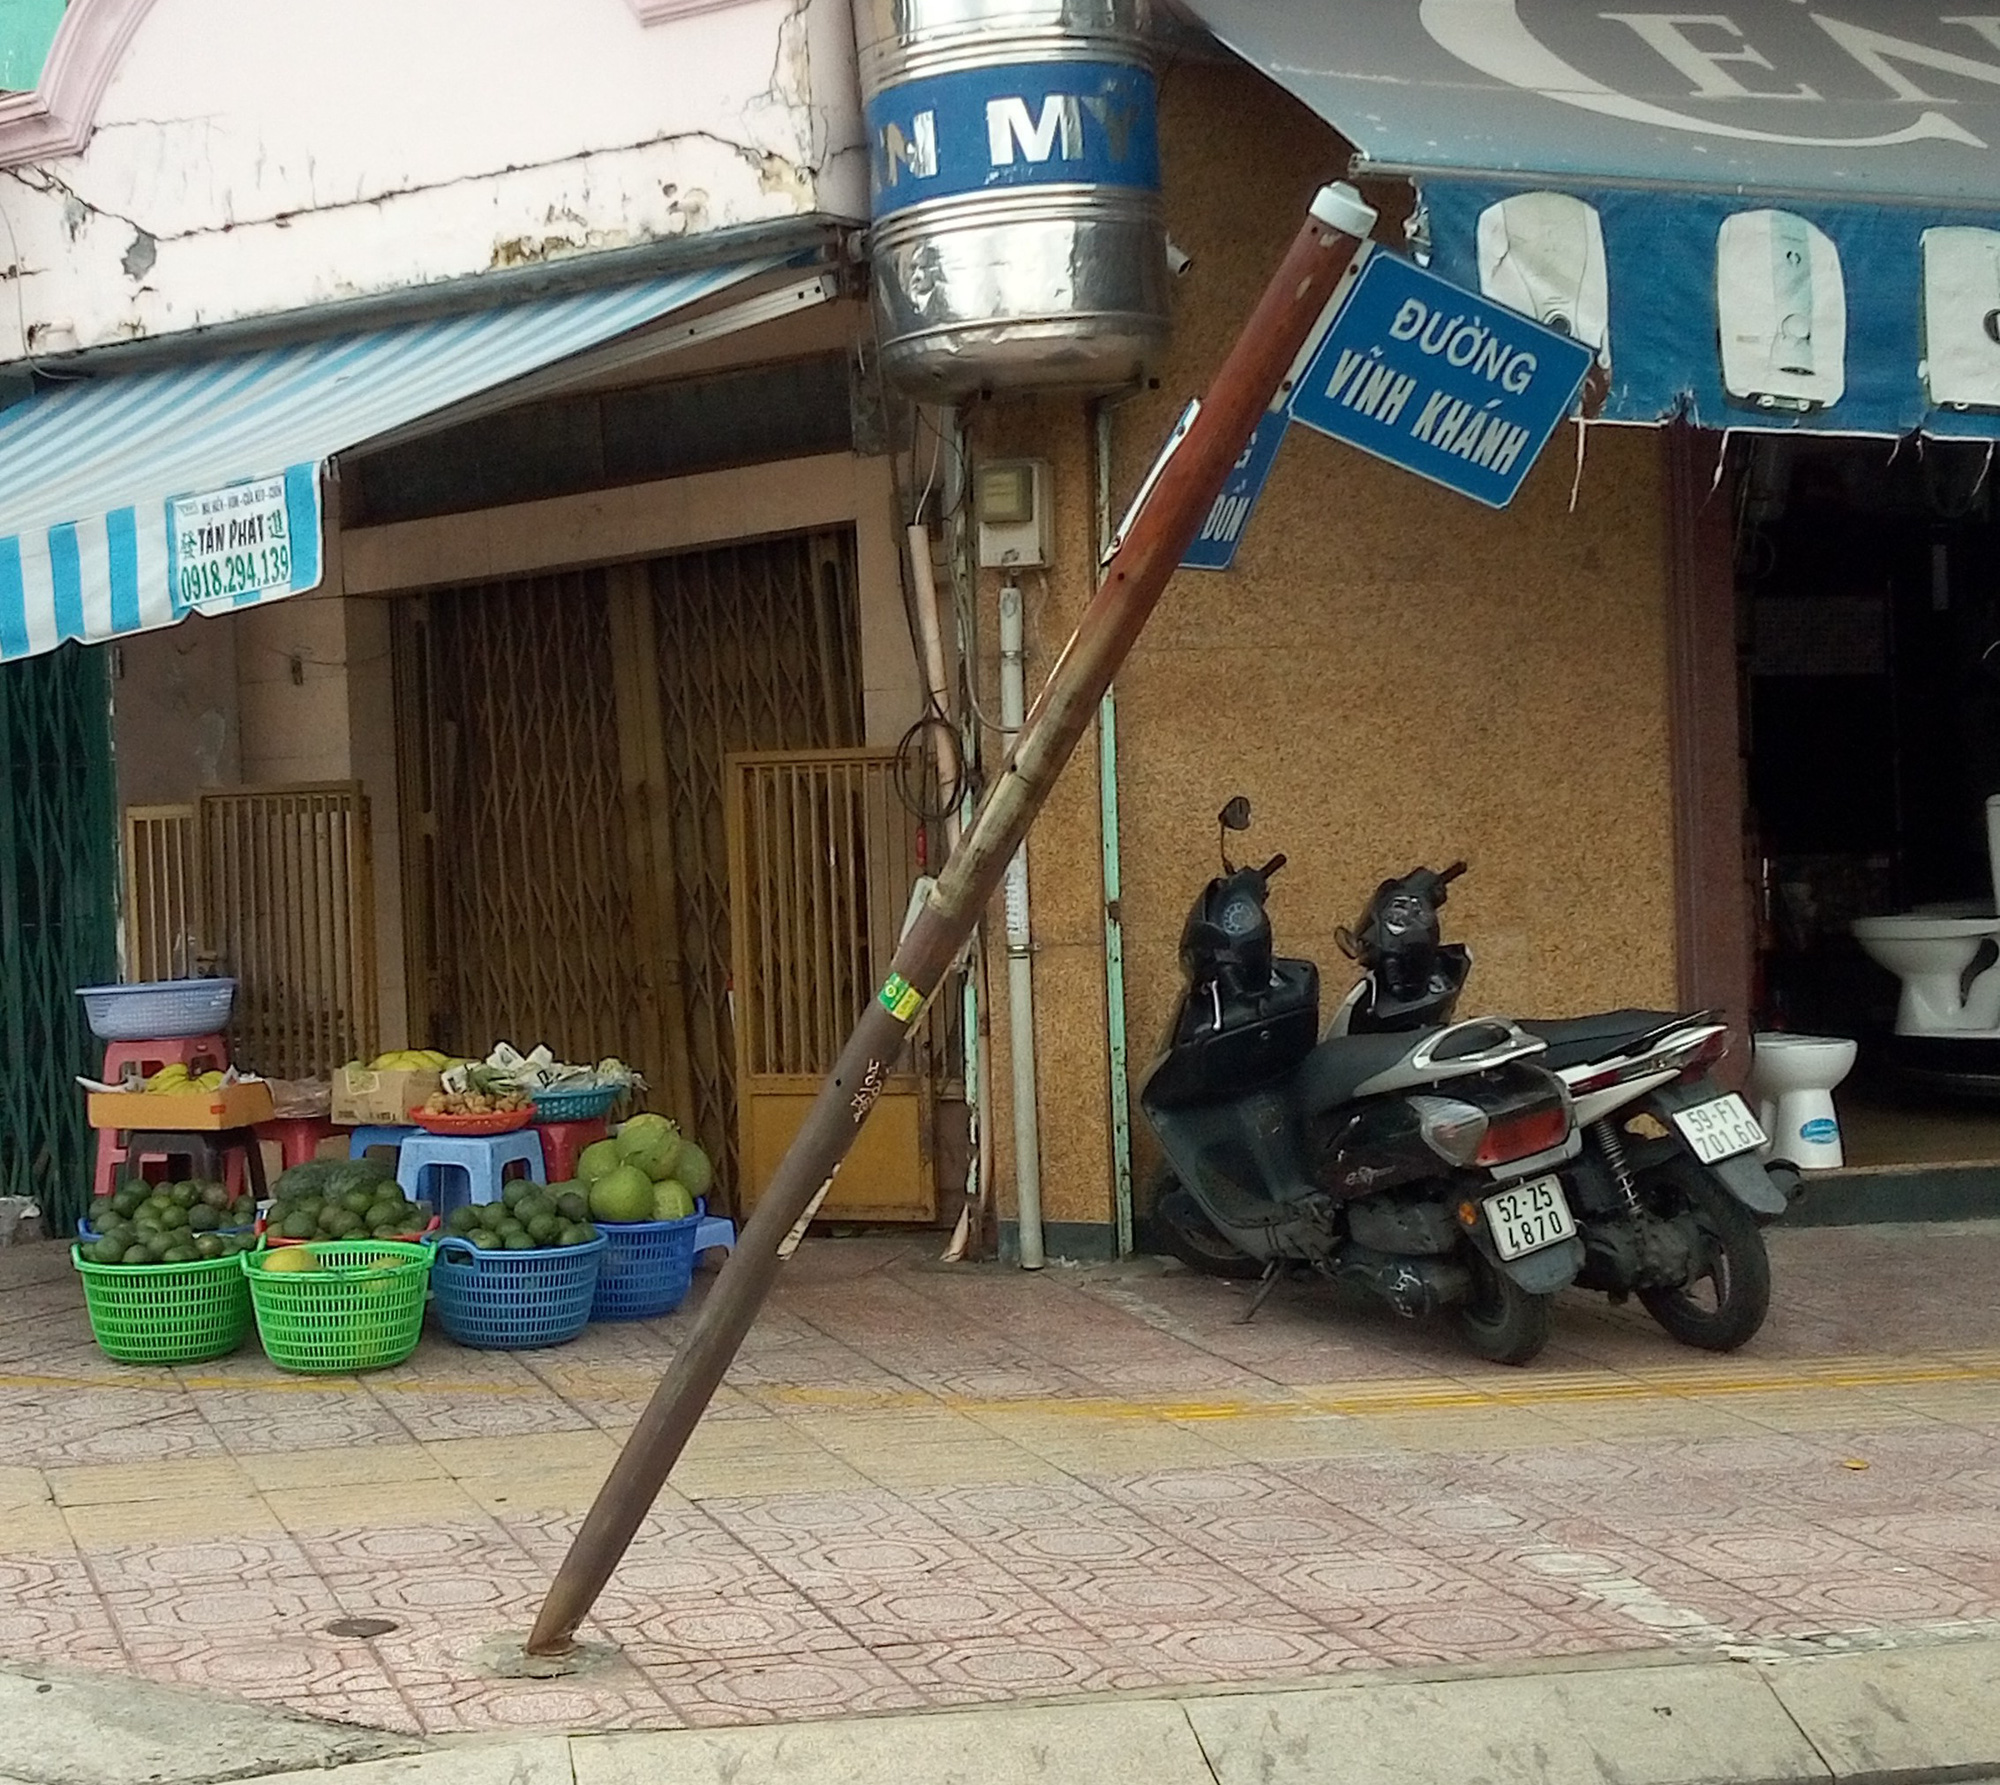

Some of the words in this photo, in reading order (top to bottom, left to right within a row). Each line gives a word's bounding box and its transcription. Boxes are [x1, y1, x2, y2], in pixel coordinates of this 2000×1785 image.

[1388, 297, 1538, 396] ĐƯỜNG
[1324, 345, 1417, 426] VĨNH
[1409, 399, 1531, 476] KHÁNH
[229, 513, 264, 550] PHÁT
[180, 545, 290, 603] 0918.294.139
[1694, 1120, 1762, 1160] 701.60
[1496, 1182, 1554, 1223] 52-Z5
[1508, 1211, 1563, 1251] 4870
